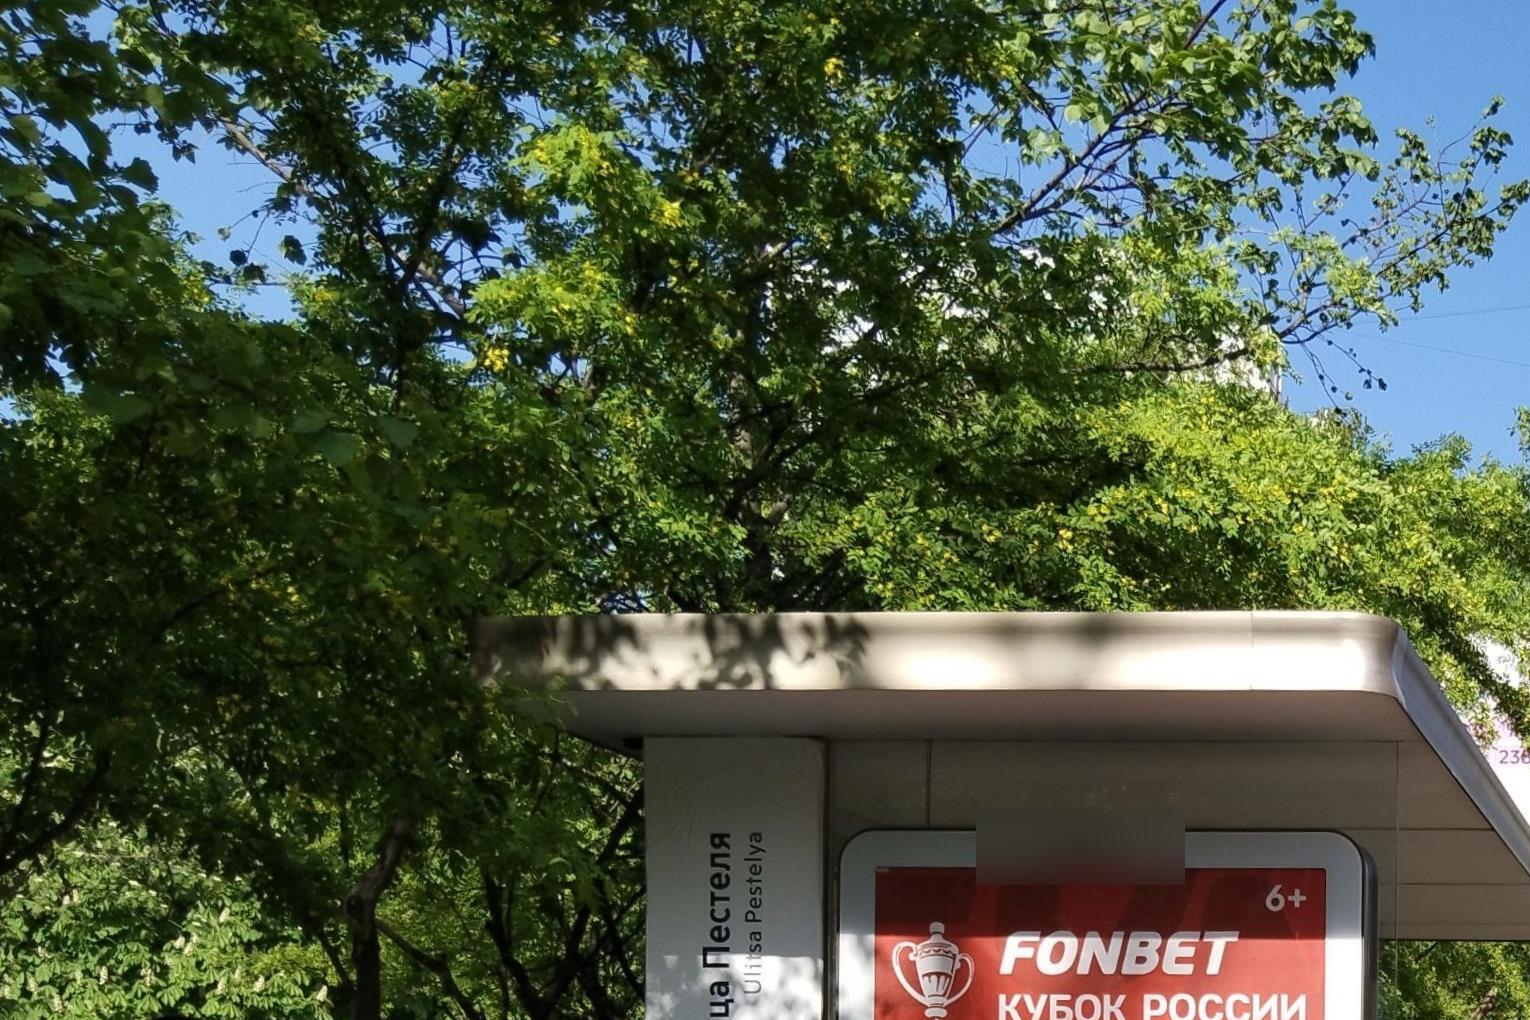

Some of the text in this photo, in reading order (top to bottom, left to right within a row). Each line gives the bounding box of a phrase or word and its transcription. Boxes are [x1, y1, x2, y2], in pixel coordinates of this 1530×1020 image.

[702, 833, 731, 969] Пестеля
[744, 832, 767, 995] Ulitsa Pestelya
[1265, 884, 1307, 912] 6+
[1000, 931, 1239, 976] FONBET
